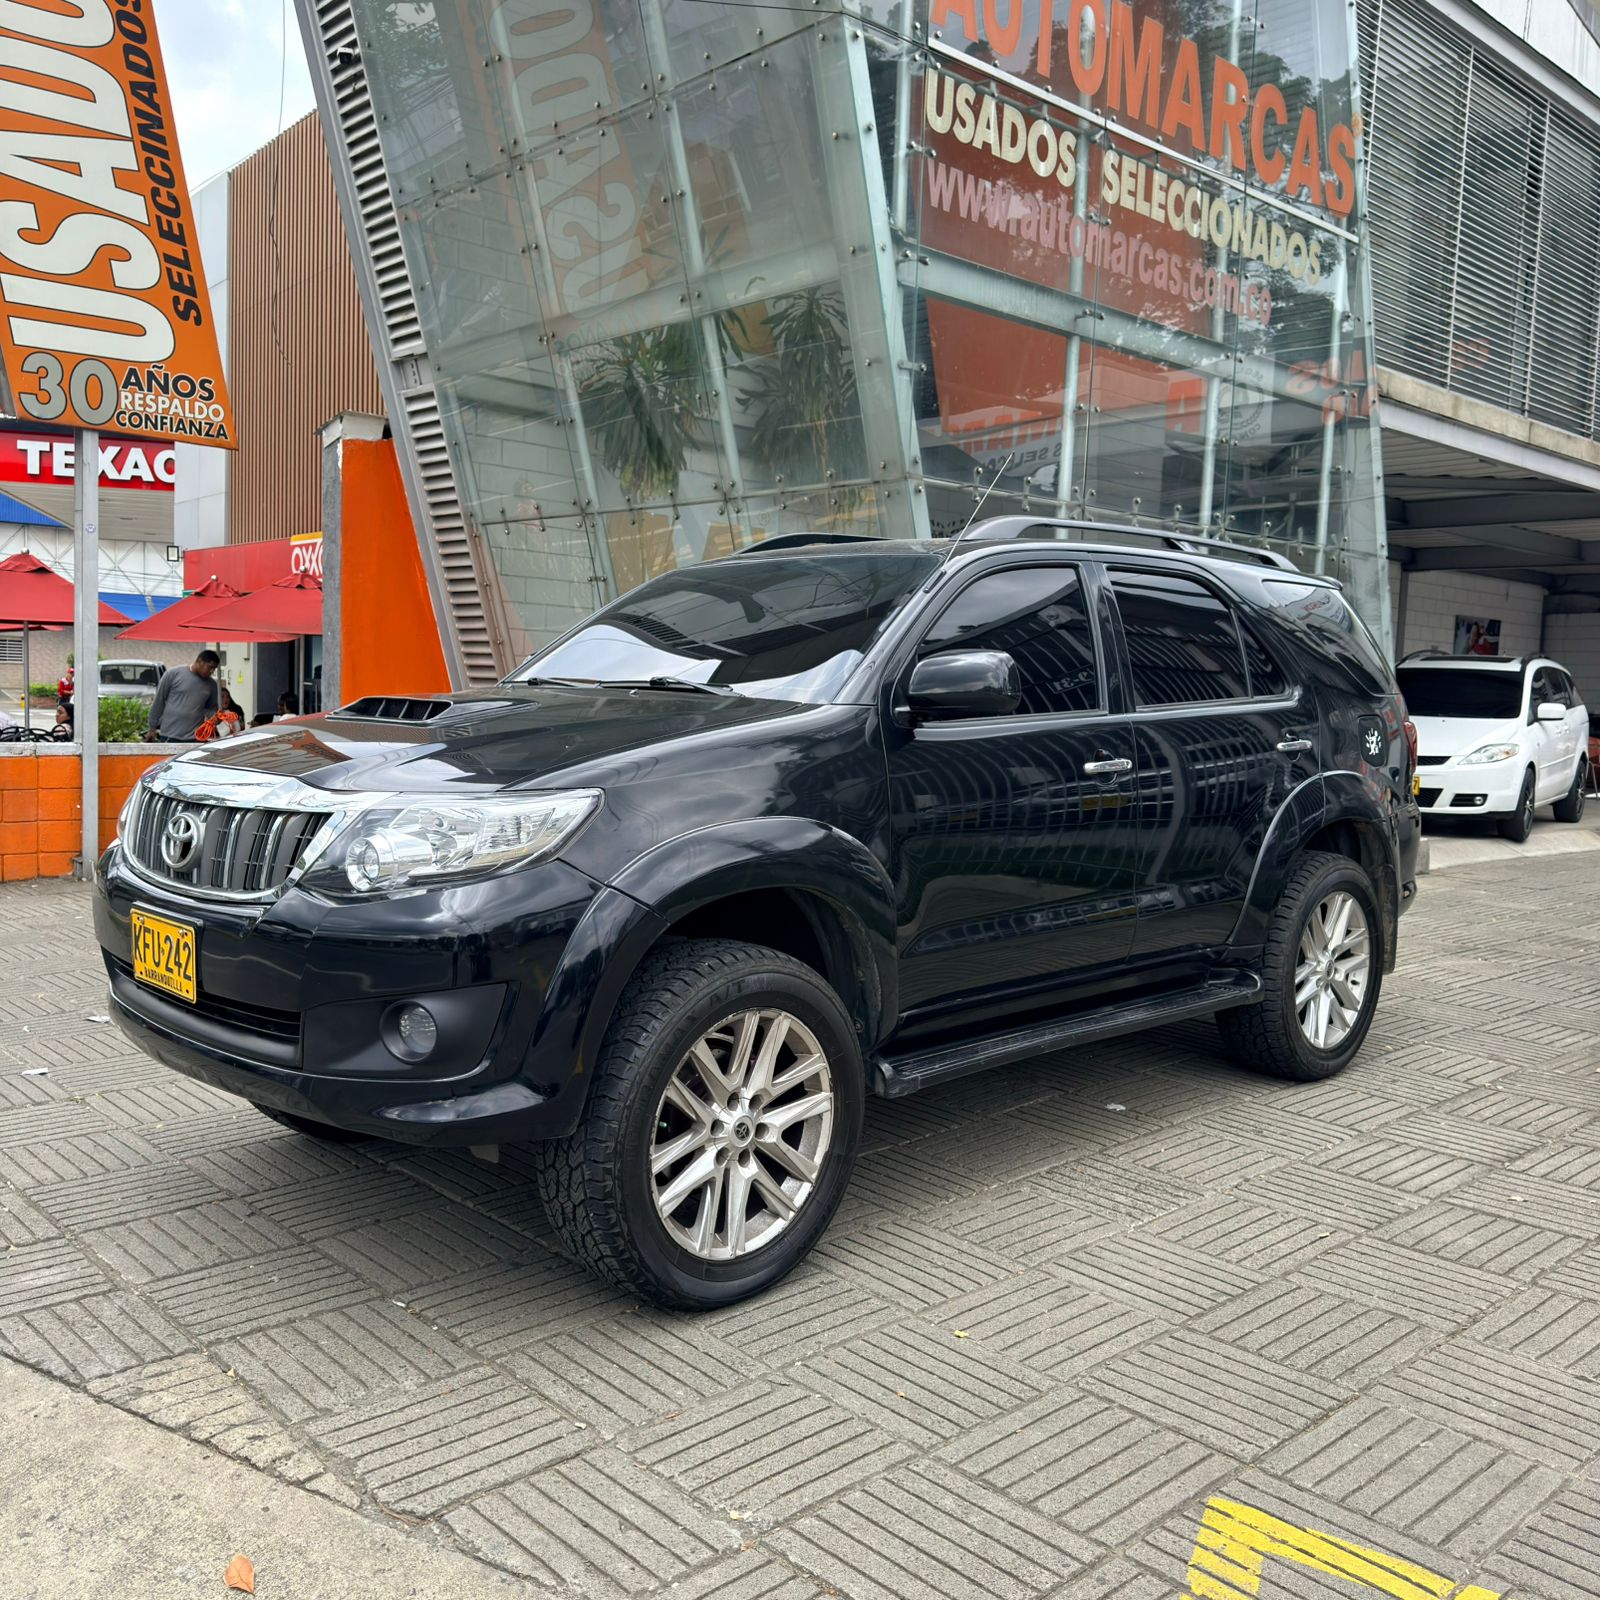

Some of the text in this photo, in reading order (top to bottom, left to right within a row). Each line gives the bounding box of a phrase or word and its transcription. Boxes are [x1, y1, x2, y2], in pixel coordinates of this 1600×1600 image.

[926, 68, 1322, 286] USADOS SELECCIONADOS
[18, 351, 215, 426] 30 AÑOS
[119, 392, 225, 423] RESPALDO
[115, 410, 229, 440] CONFIANZA
